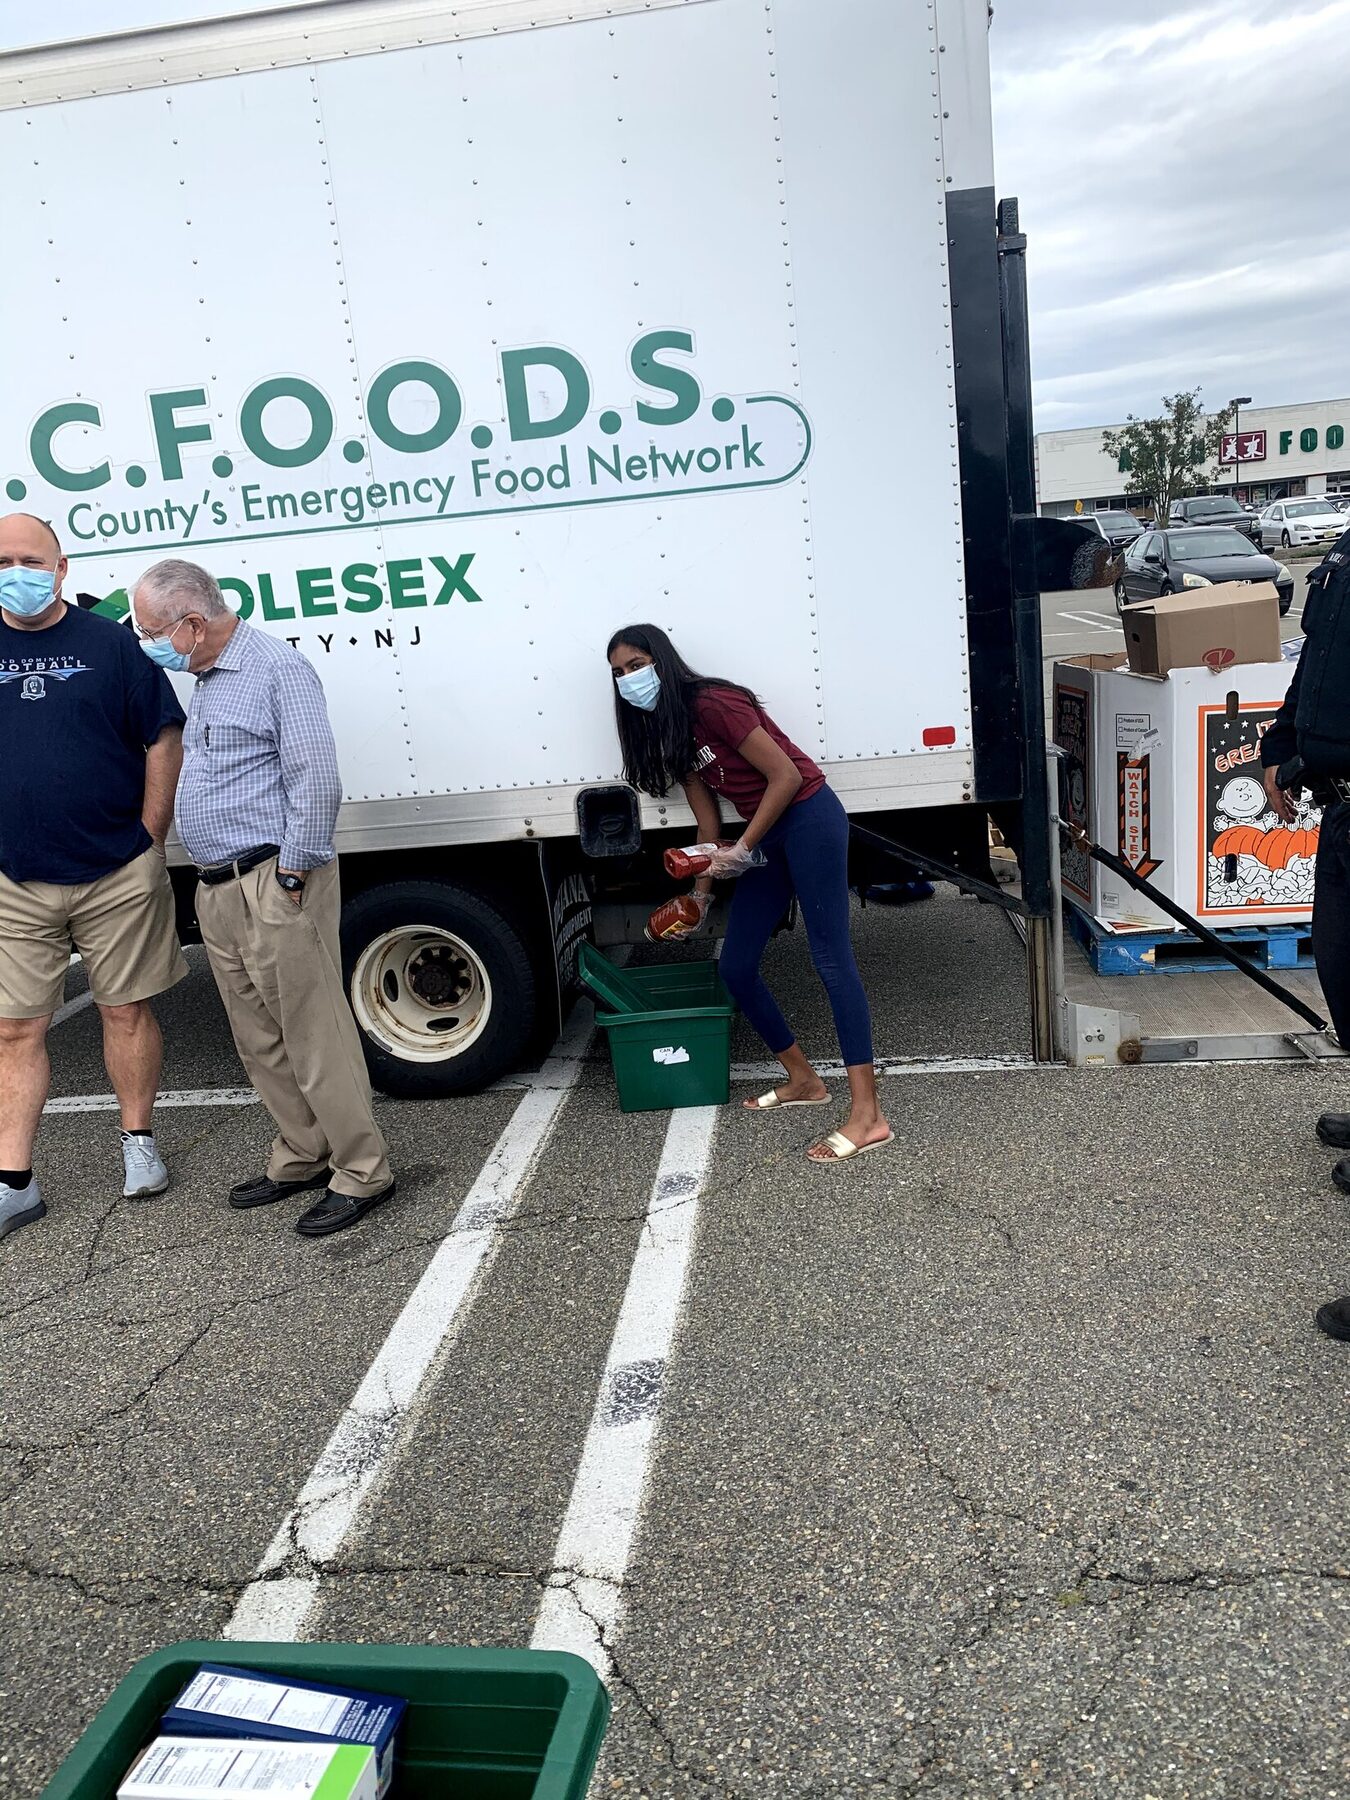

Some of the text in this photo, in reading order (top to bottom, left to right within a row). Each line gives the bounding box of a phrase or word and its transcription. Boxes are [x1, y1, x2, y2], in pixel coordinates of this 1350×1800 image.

[68, 424, 766, 540] County's Emergency Food Network
[215, 552, 484, 622] DLESEX
[21, 655, 74, 664] DOMINION
[1214, 739, 1262, 773] GREA
[1127, 772, 1140, 818] WATCH
[1129, 825, 1140, 861] STEP
